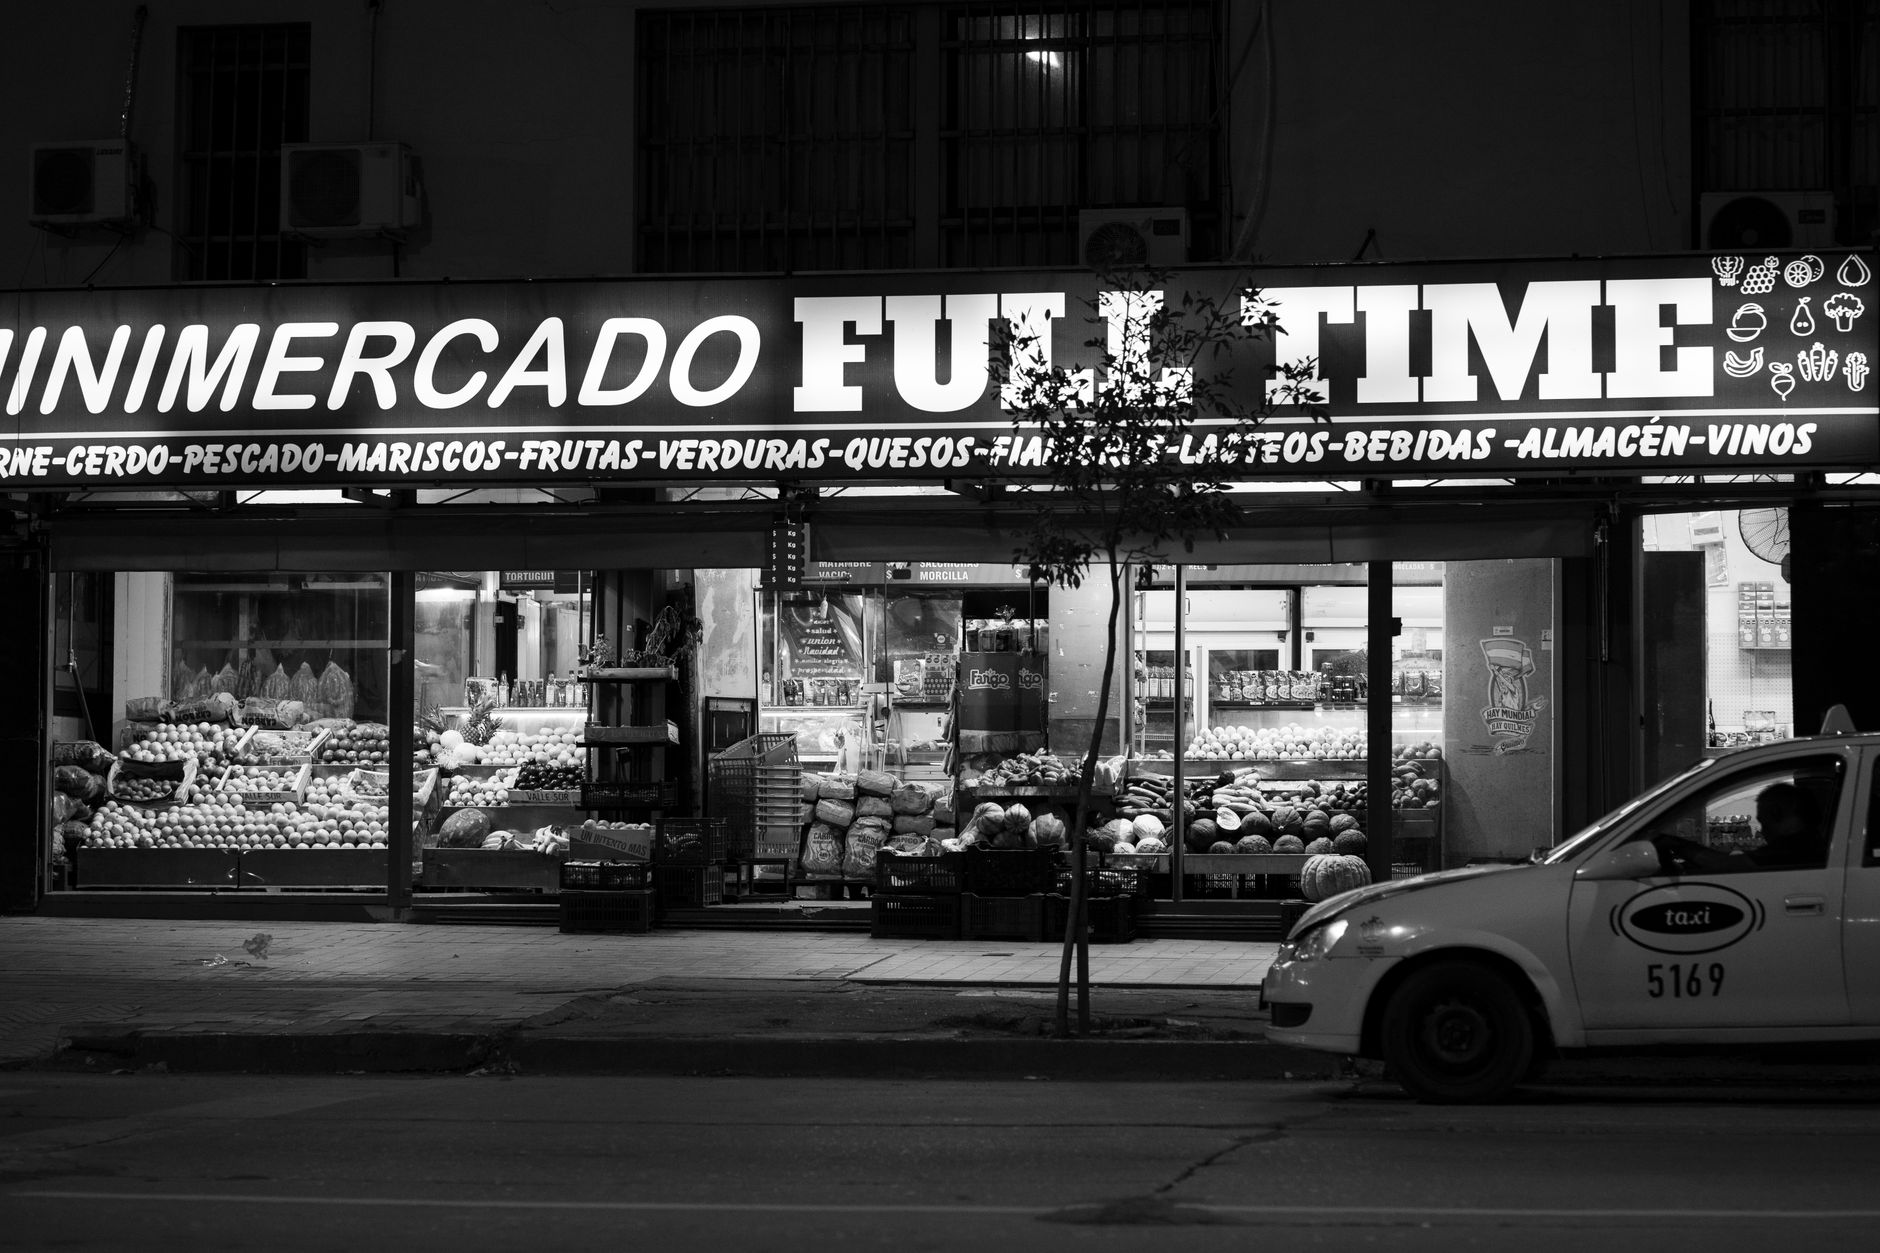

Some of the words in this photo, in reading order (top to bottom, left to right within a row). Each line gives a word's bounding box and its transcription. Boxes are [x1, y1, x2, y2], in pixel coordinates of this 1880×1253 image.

[794, 290, 1194, 412] FULL
[1240, 278, 1715, 405] TIME
[919, 570, 969, 581] MORCILLA
[969, 669, 1010, 689] Fango
[1486, 709, 1501, 720] HAY
[1501, 709, 1535, 721] MUNDIAL
[1491, 723, 1503, 731] HAY
[1503, 723, 1531, 733] QUILMES
[526, 791, 549, 801] VALLE
[553, 792, 569, 801] SUR
[581, 829, 593, 842] UN
[1664, 906, 1711, 926] taxi
[1647, 962, 1725, 998] 5169
